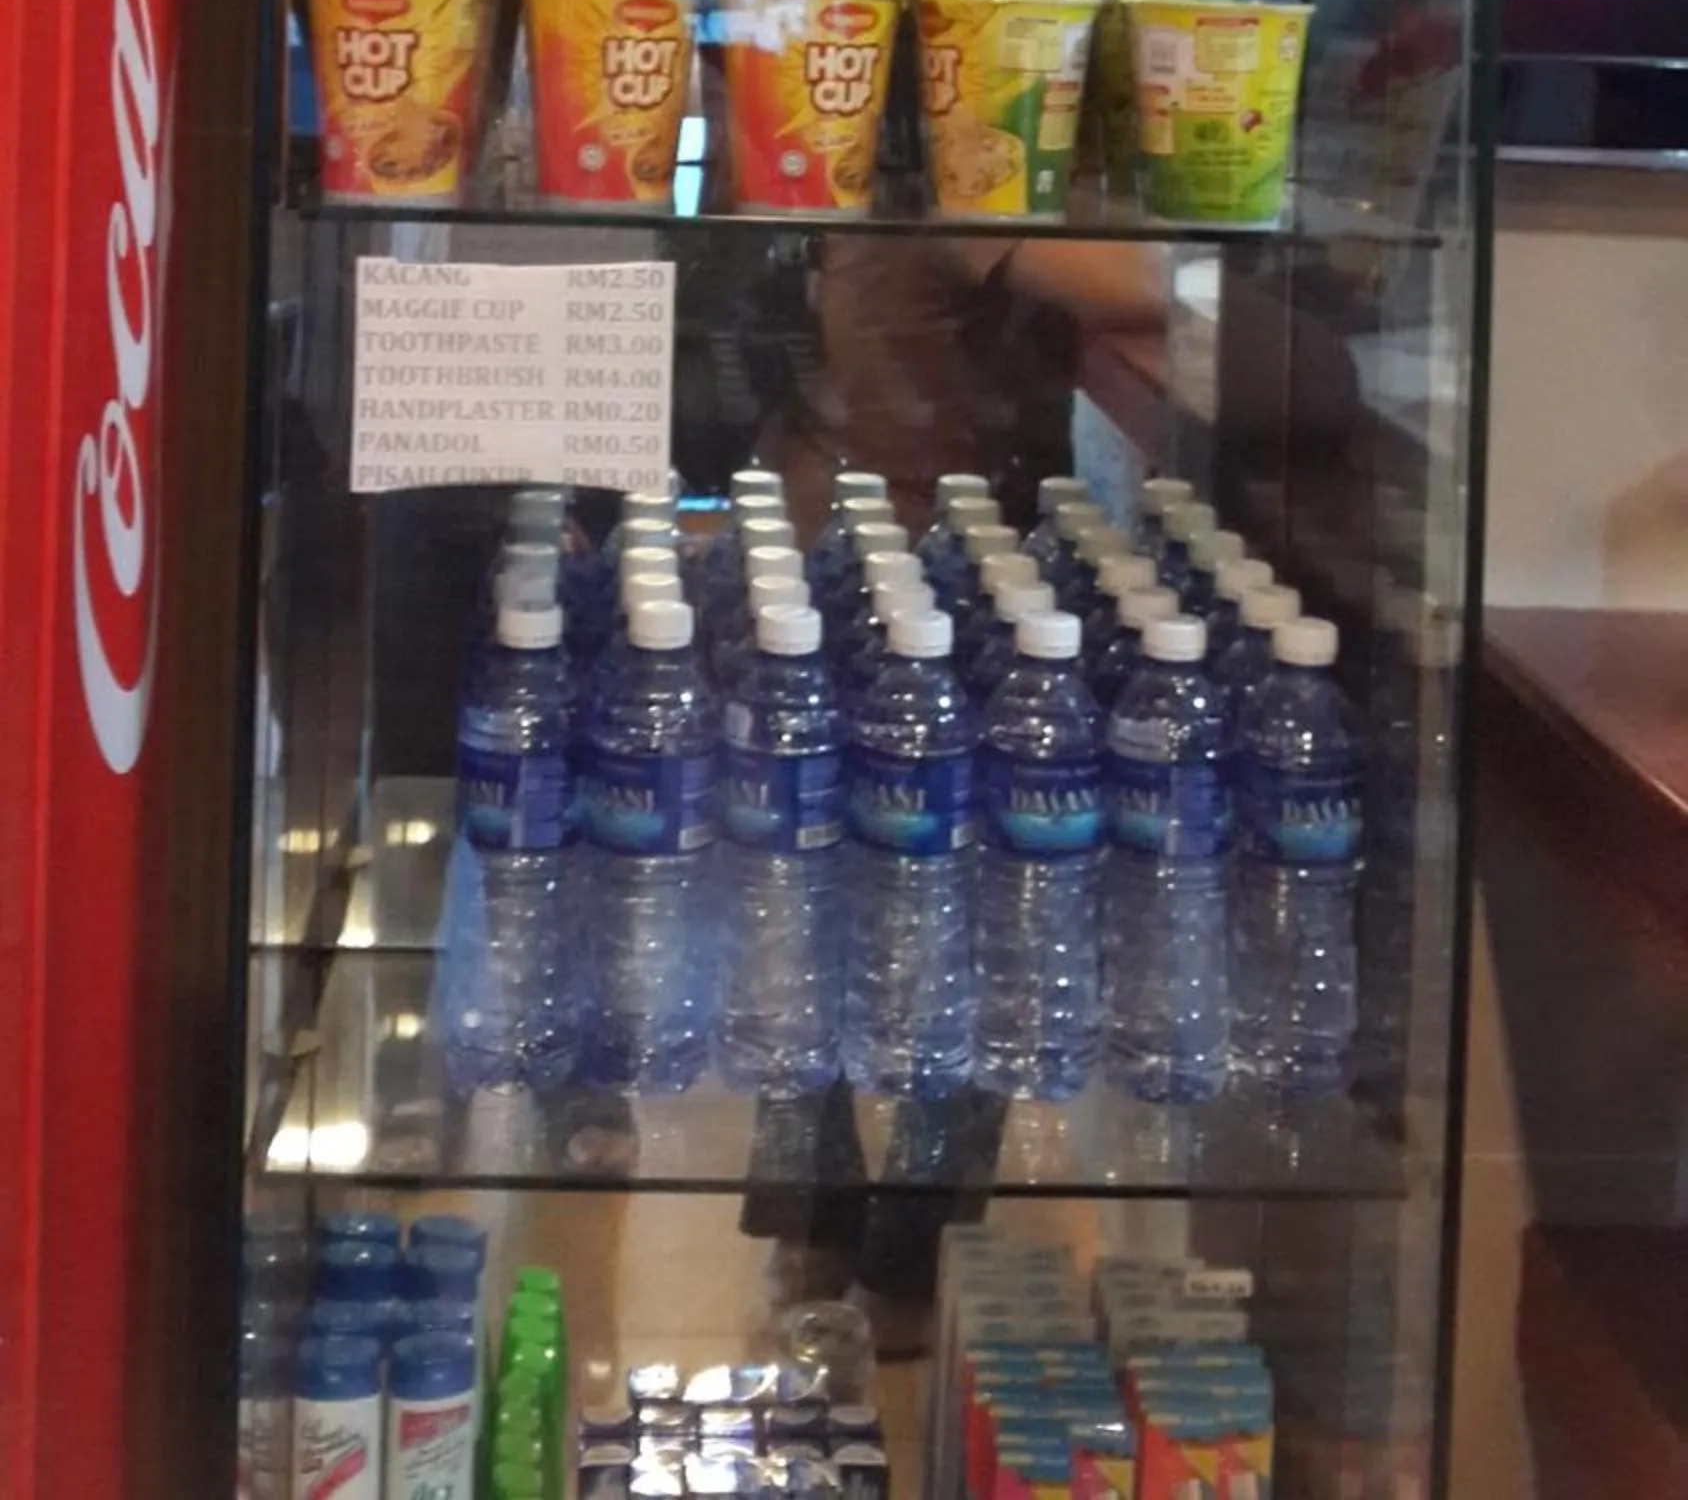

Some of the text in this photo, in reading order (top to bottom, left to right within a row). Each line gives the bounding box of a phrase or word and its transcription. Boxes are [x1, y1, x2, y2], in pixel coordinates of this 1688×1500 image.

[335, 28, 418, 68] HOT
[603, 37, 680, 76] HOT
[805, 43, 881, 83] HOT
[341, 64, 410, 101] CUP
[610, 72, 672, 108] CUP
[810, 79, 873, 115] CUP
[362, 263, 665, 290] KACANG RM2.50
[473, 299, 525, 321] CUP
[565, 301, 664, 323] RM2.50
[361, 332, 663, 356] TOOTHPASTE RM3.00
[360, 366, 663, 389] TOOTHBRUSH RM4.00
[359, 399, 662, 422] HANDPLASTER RM0.20
[358, 432, 660, 456] PANADOL RM0.50
